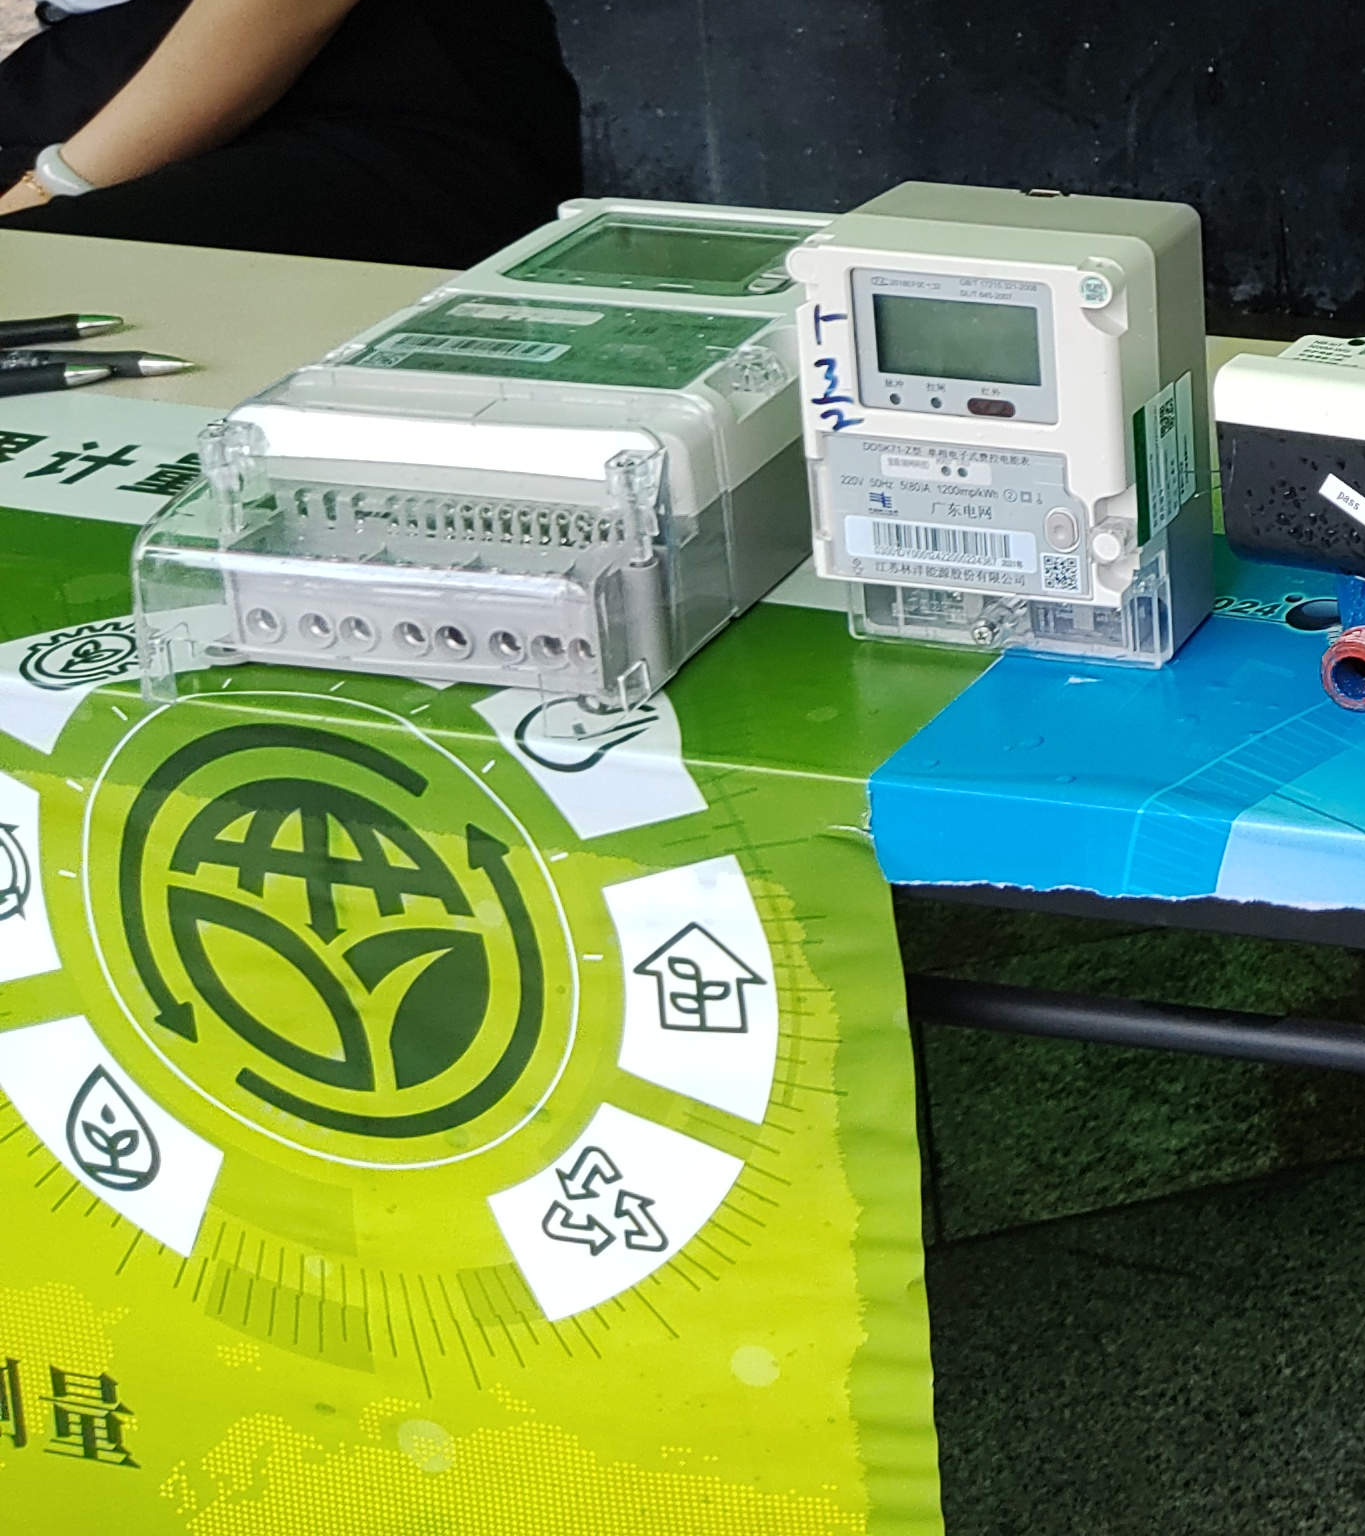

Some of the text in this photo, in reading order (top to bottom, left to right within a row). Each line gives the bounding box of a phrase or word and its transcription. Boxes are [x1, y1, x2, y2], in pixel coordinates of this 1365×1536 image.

[930, 501, 993, 520] 广东电网
[1336, 490, 1361, 511] pass
